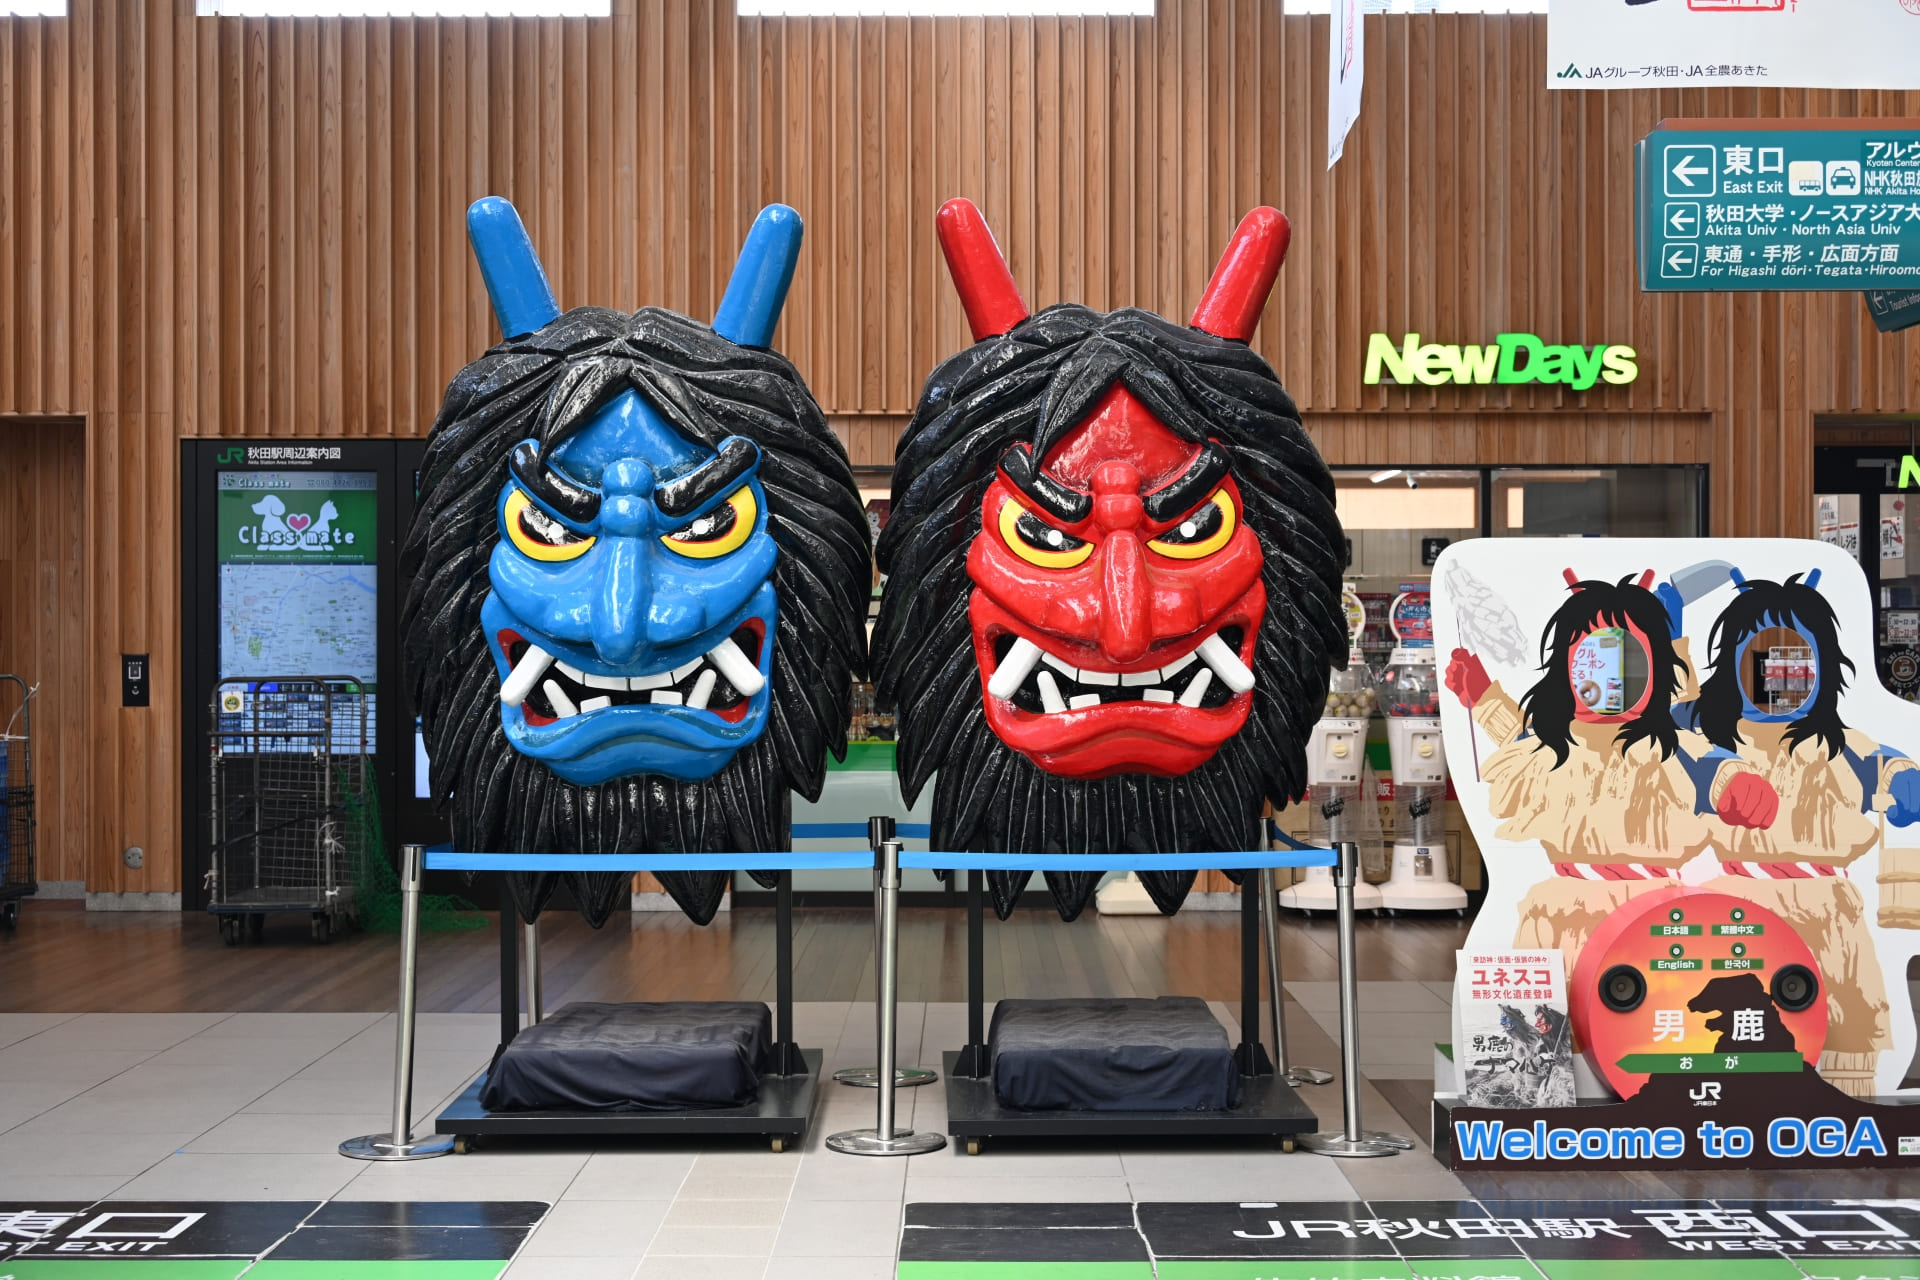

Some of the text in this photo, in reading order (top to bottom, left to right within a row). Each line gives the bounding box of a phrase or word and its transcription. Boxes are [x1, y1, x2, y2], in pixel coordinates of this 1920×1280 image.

[1723, 145, 1784, 175] 東口
[1723, 181, 1784, 194] East Exit
[1864, 187, 1882, 195] NHK
[1886, 187, 1908, 195] Akita
[1704, 223, 1902, 236] Akita Univ North Asia Univ
[1701, 265, 1725, 276] For
[1729, 265, 1778, 278] Higashi
[1364, 333, 1639, 390] NewDays
[248, 447, 341, 459] 秋田駅周辺案内図
[1663, 926, 1689, 935] 日本語
[1657, 960, 1695, 970] English
[1724, 960, 1750, 969] 한국어
[1472, 968, 1552, 987] ユネスコ
[1472, 989, 1553, 1000] 無形文化遺産登録
[1689, 1082, 1722, 1100] JR
[1455, 1117, 1887, 1160] Welcome to OGA
[1233, 1209, 1910, 1240] JR秋田駅 西口
[54, 1242, 169, 1251] EXIT
[1667, 1240, 1807, 1251] WEST
